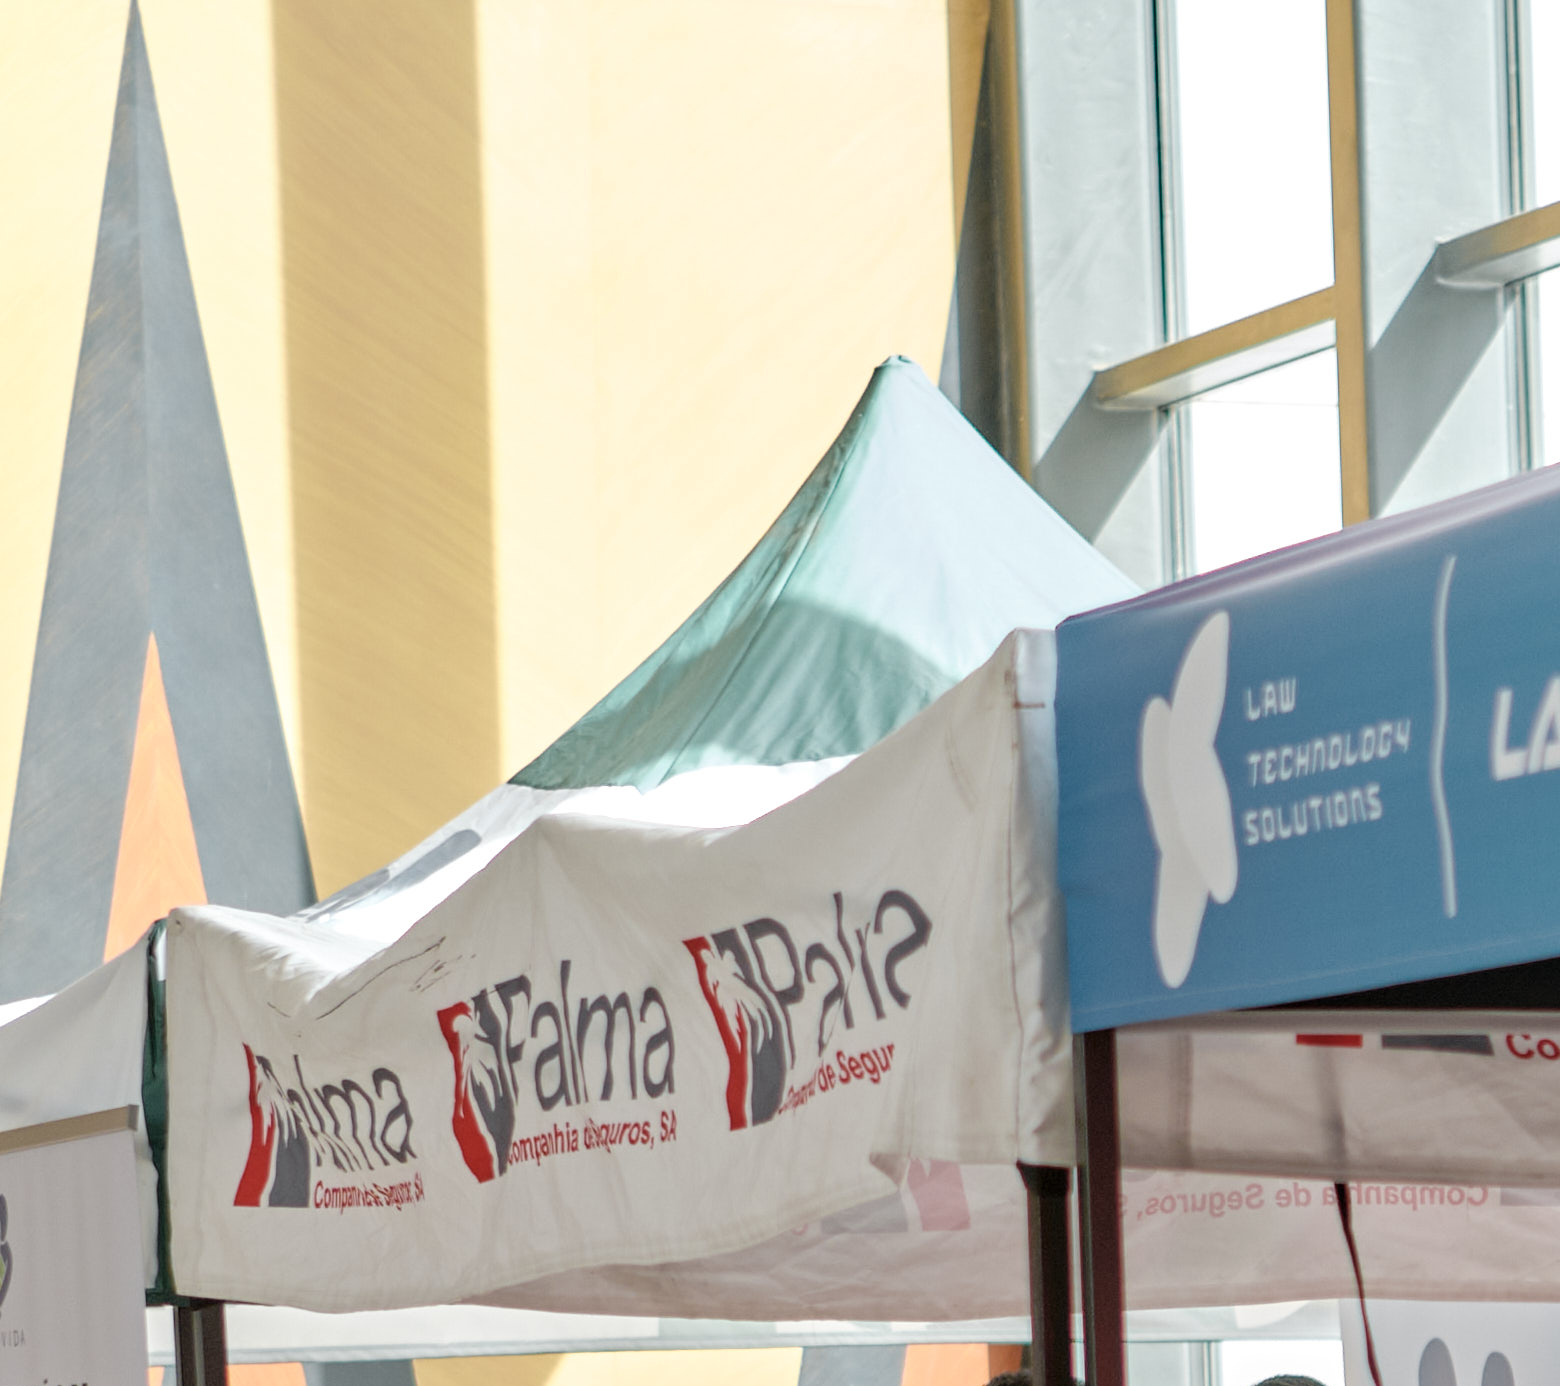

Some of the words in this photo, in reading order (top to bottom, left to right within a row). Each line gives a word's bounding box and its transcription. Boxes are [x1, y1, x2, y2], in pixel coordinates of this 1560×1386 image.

[1245, 676, 1297, 722] LAW
[1246, 717, 1412, 788] TECHNOLOGY
[1244, 782, 1383, 846] SOLUTIONS
[660, 1109, 677, 1144] SA
[1, 1328, 26, 1348] VIDA
